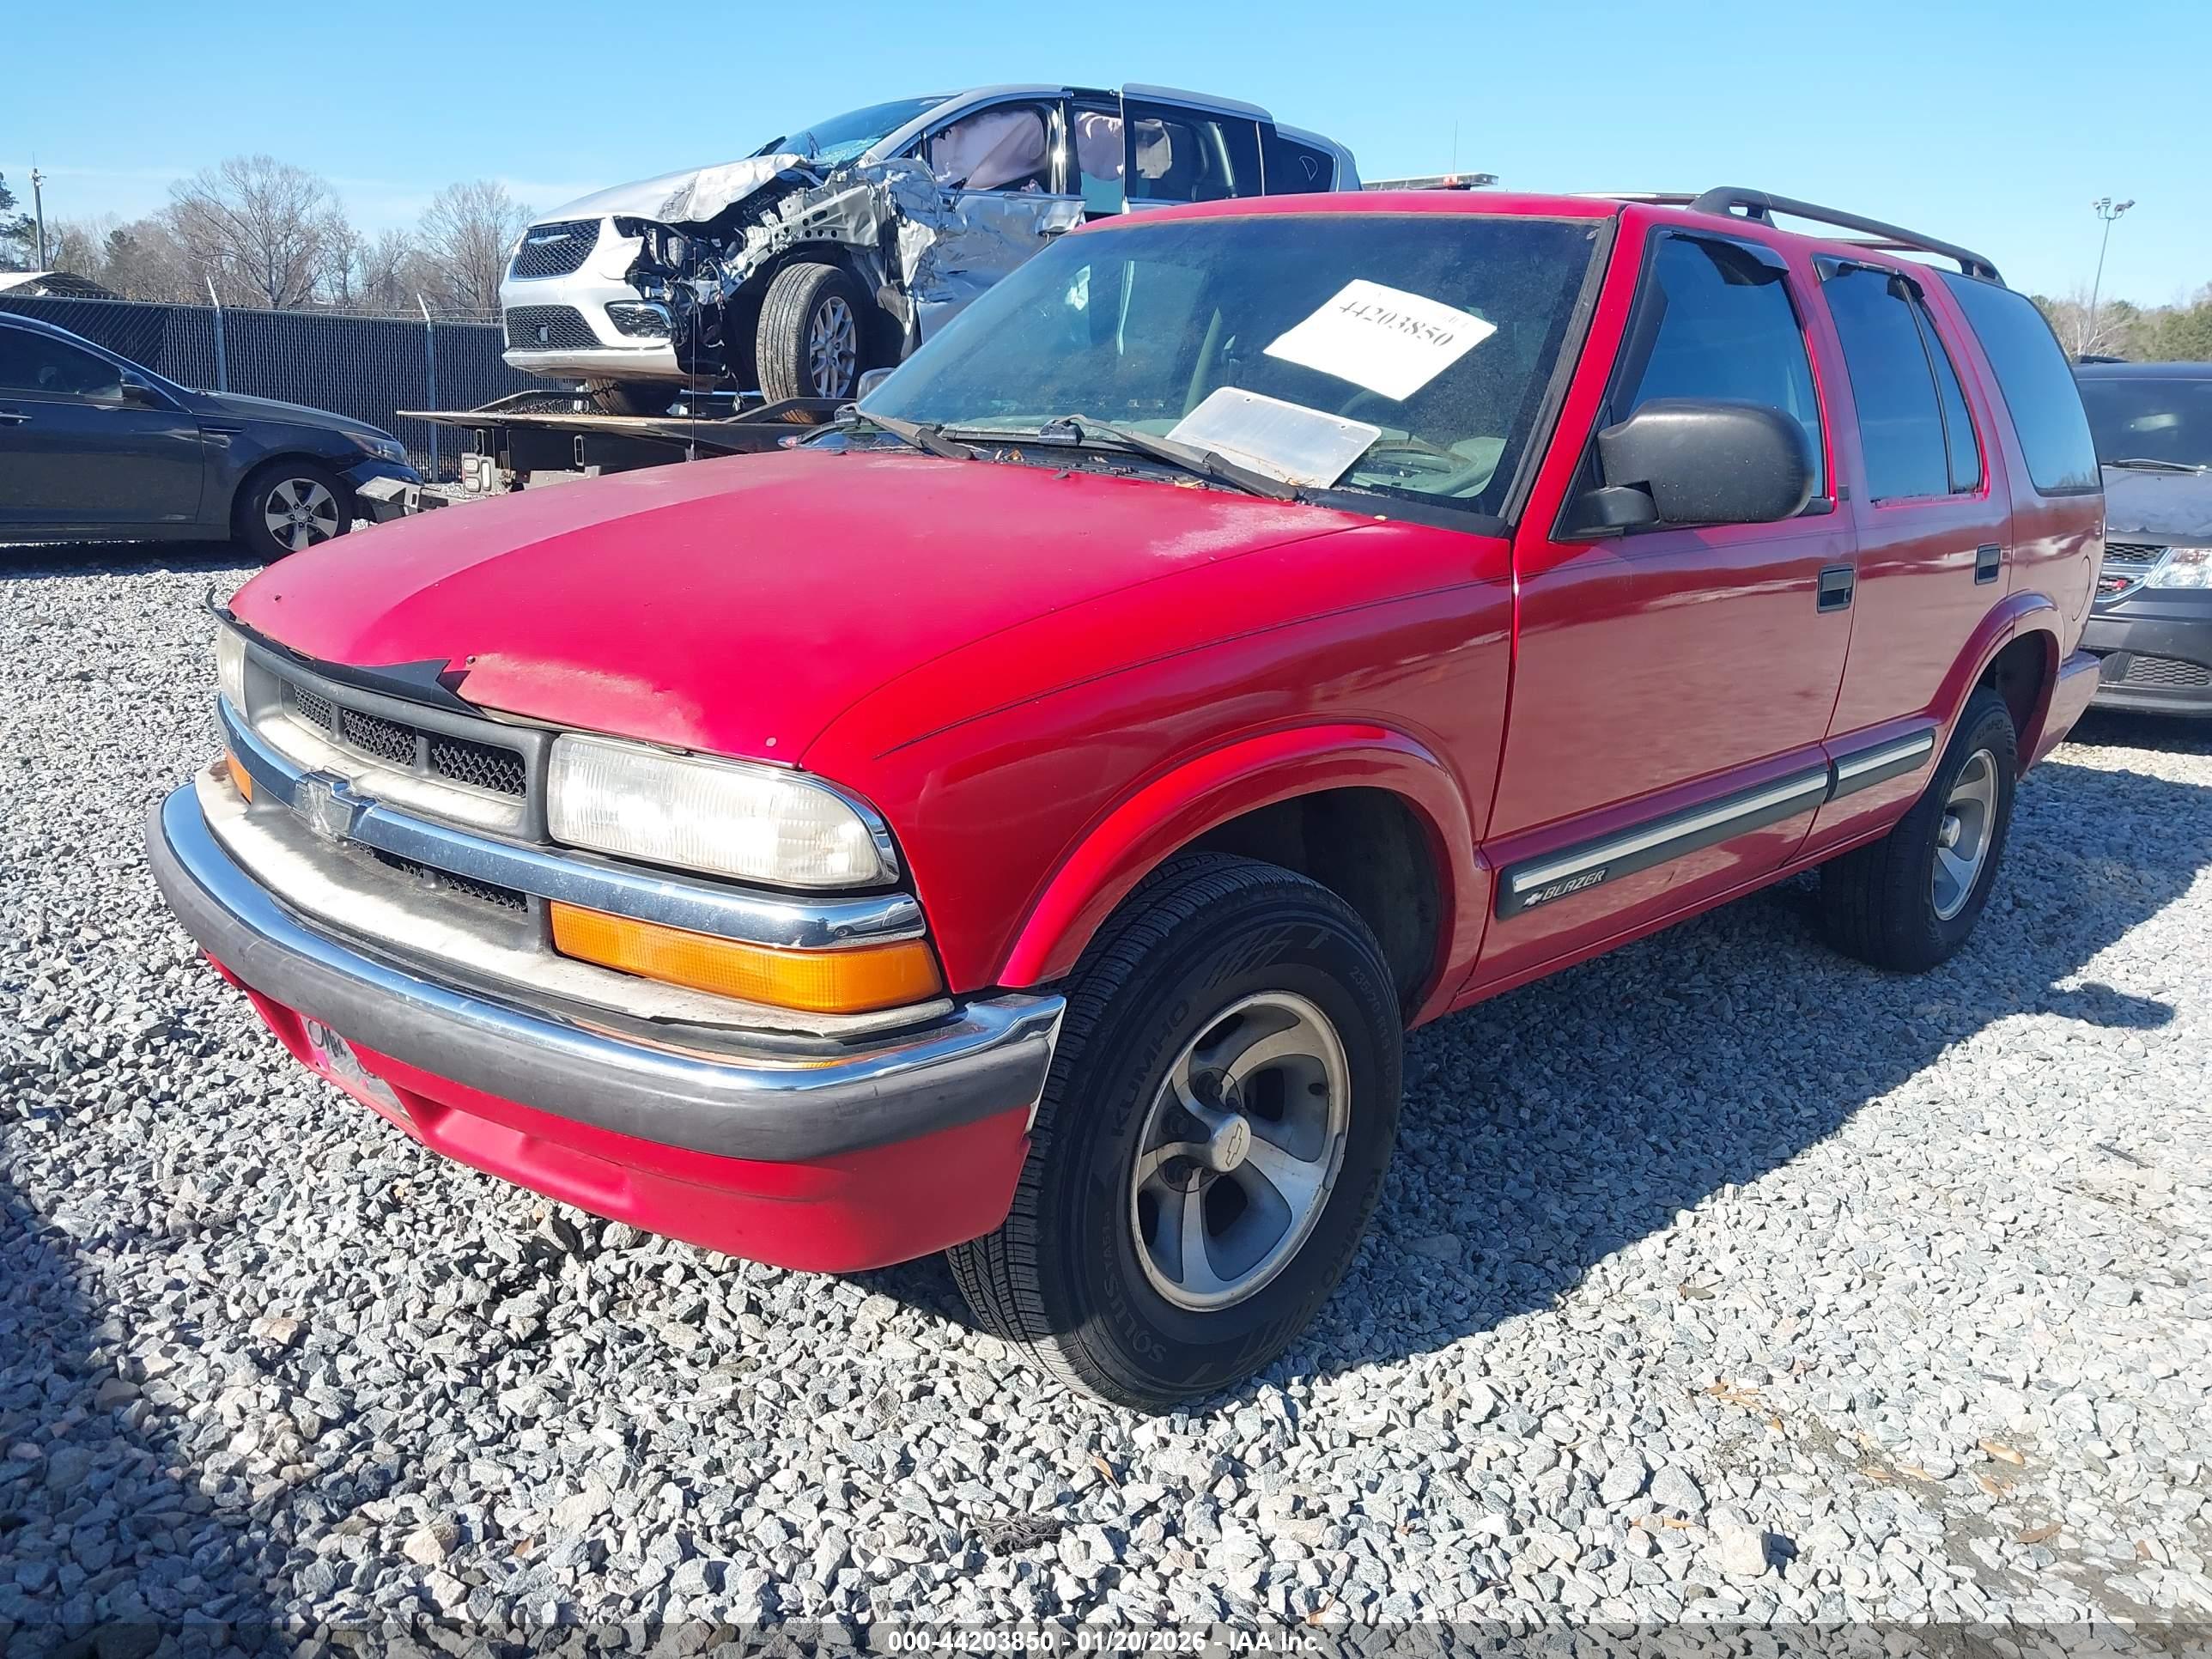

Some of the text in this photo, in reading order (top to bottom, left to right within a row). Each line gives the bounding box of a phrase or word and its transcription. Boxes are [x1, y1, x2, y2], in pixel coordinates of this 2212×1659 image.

[1339, 301, 1455, 347] 44203850
[1541, 869, 1605, 902] BLAZER
[1110, 999, 1189, 1138] KUMHO
[1103, 1272, 1167, 1364] SOLUS
